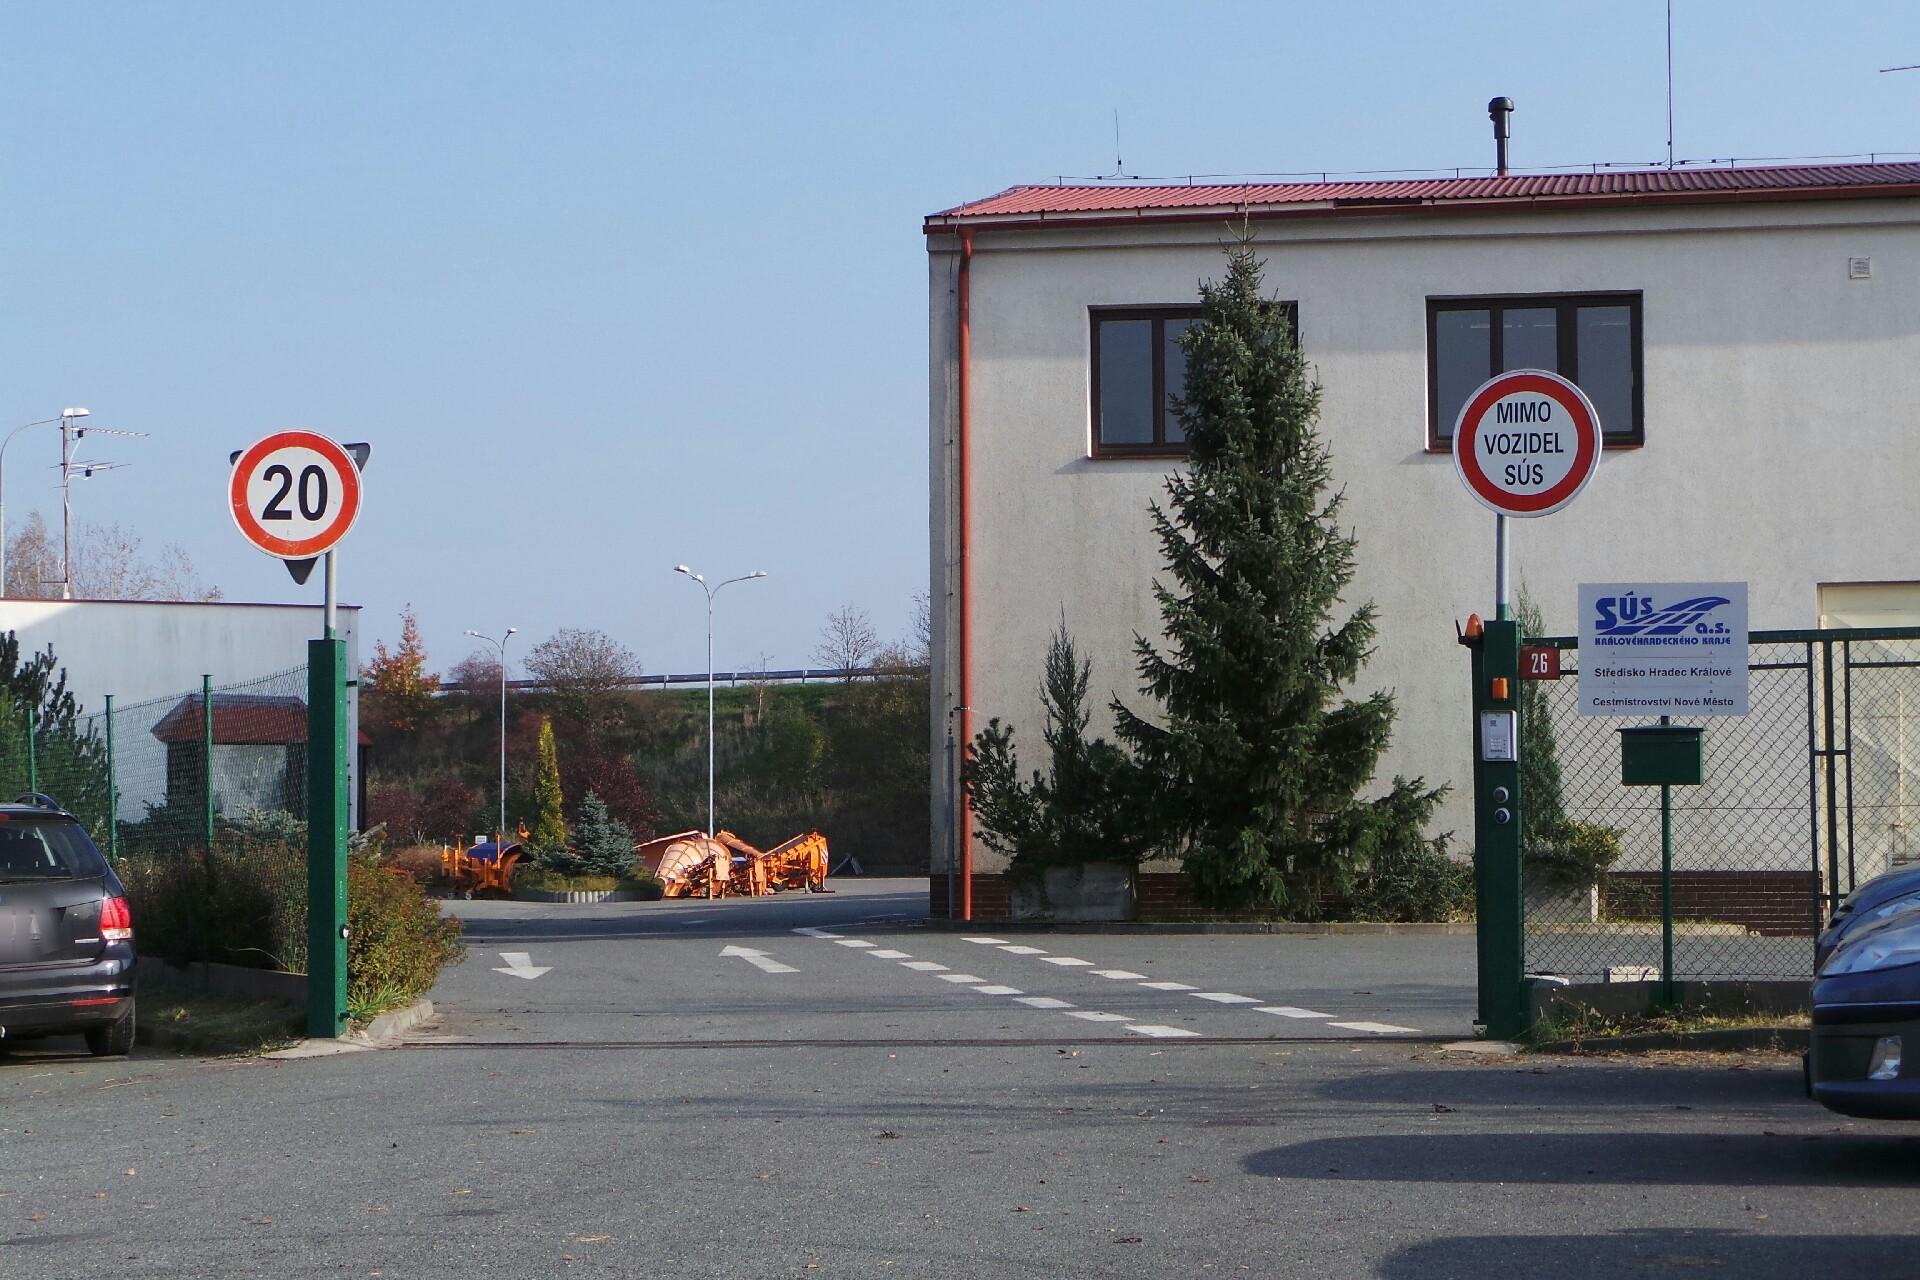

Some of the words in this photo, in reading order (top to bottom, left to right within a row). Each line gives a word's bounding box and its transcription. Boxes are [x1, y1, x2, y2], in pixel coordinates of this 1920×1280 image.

[1497, 401, 1551, 423] MIMO
[1484, 432, 1564, 455] VOZIDEL
[1504, 457, 1544, 486] SÚS
[262, 464, 328, 522] 20
[1595, 591, 1653, 630] SÚS
[1695, 622, 1731, 634] a.s.
[1594, 635, 1699, 646] KRÁLOVÉHRADECKÉHO
[1702, 636, 1731, 645] KRAJE
[1531, 652, 1548, 673] 26
[1594, 667, 1646, 677] Středisko
[1649, 667, 1687, 677] Hradec
[1690, 667, 1732, 677] Králové
[1592, 697, 1671, 706] Cestmistrovství
[1674, 697, 1700, 706] Nové
[1703, 697, 1734, 706] Město
